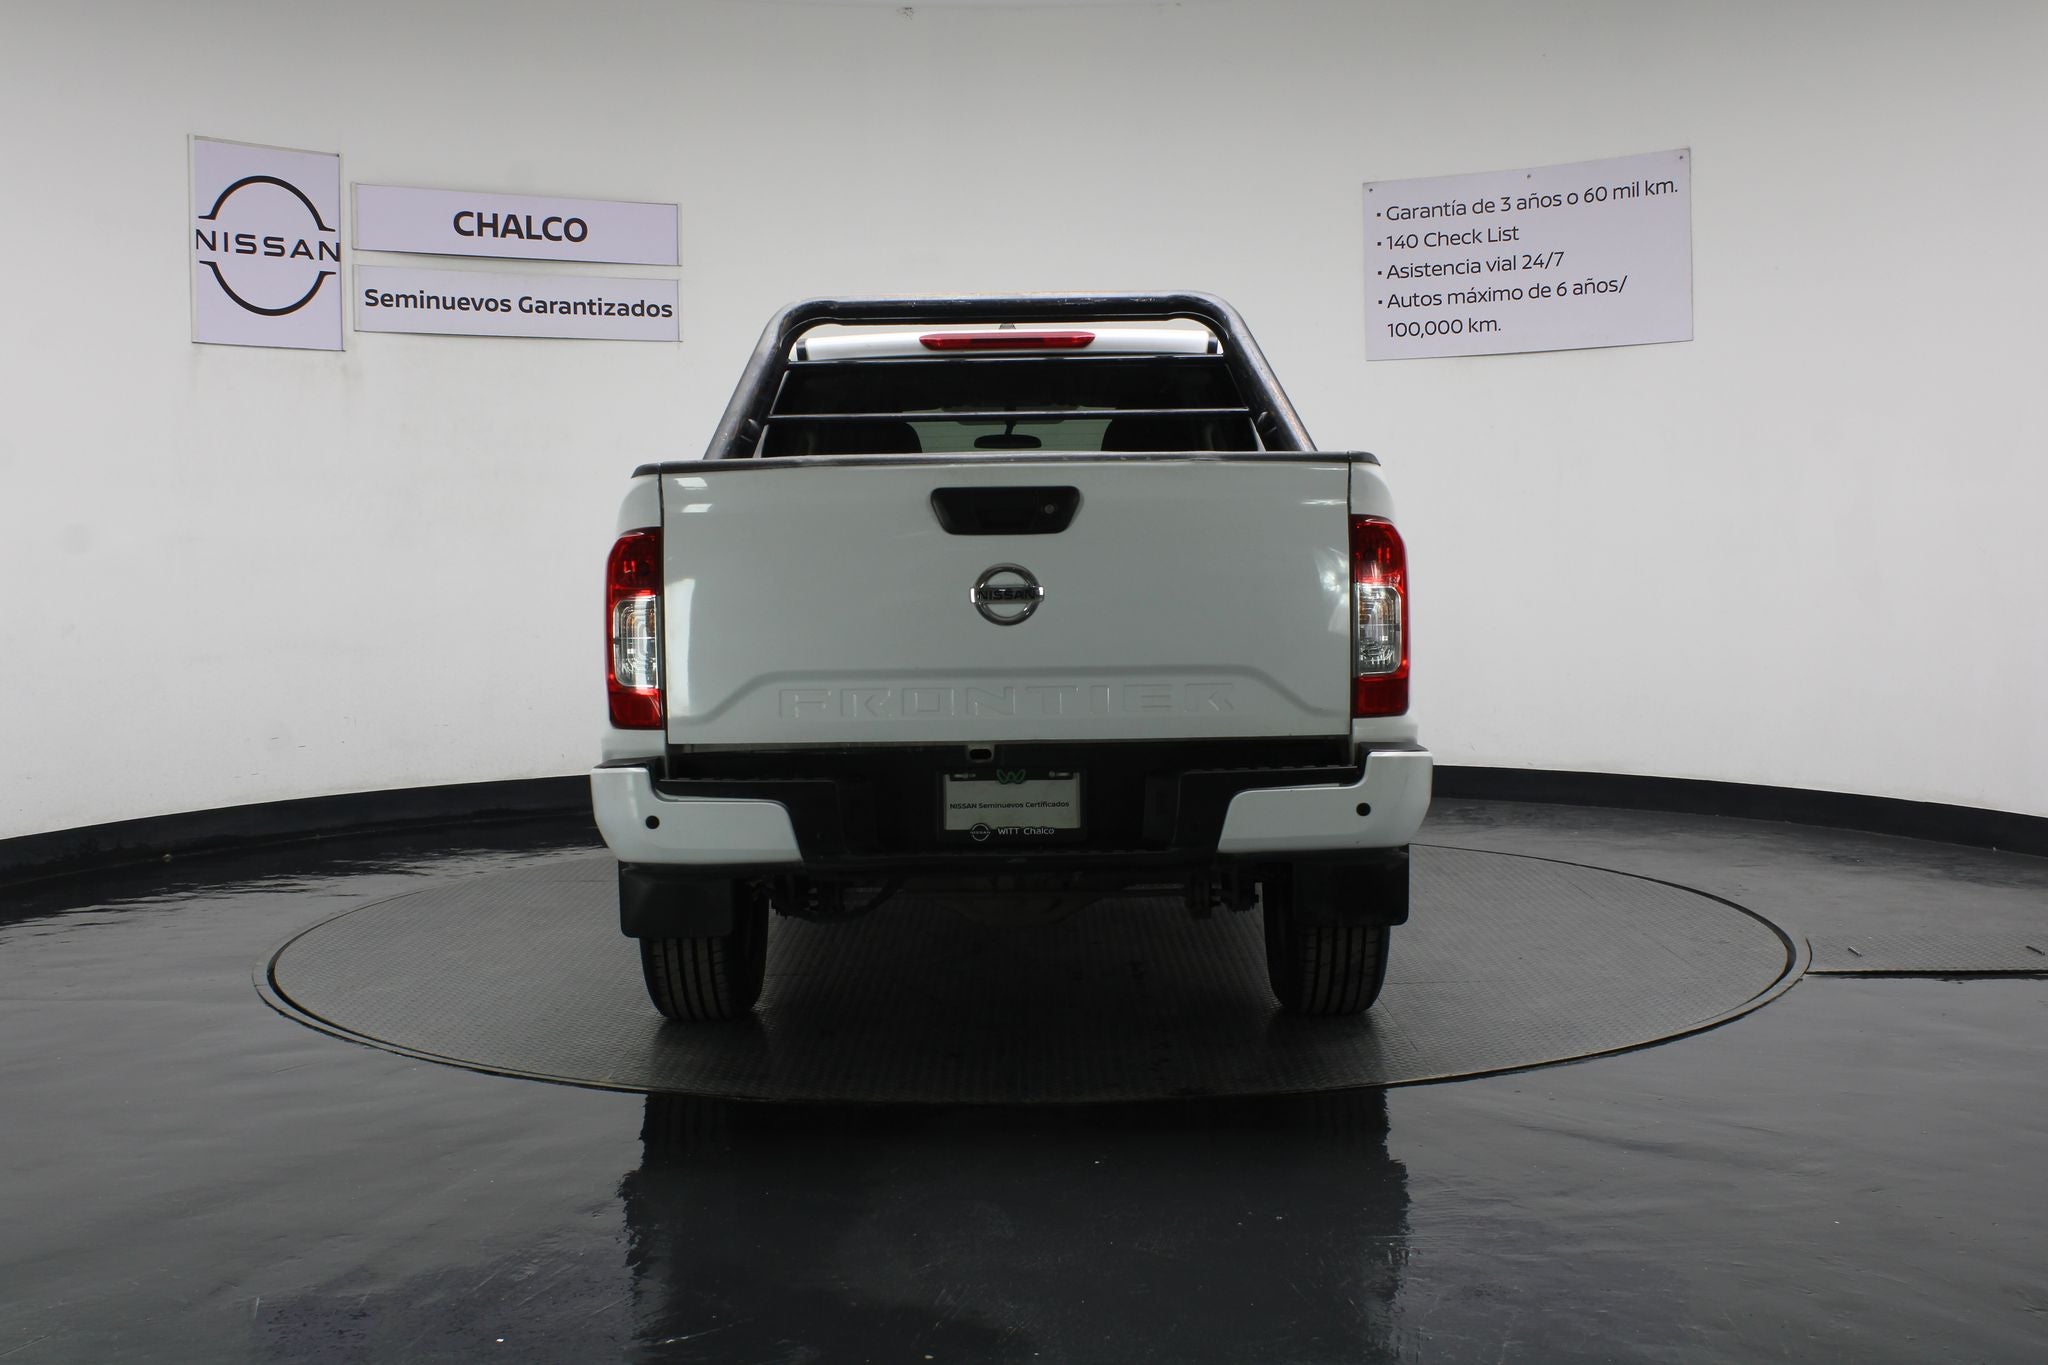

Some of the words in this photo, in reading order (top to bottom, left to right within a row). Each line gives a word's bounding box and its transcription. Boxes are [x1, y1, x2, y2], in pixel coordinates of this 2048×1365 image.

[1386, 199, 1467, 221] Garantía
[1472, 198, 1495, 215] de
[1500, 196, 1511, 213] 3
[1516, 192, 1562, 211] años
[1567, 192, 1579, 206] o
[1584, 185, 1608, 204] 60
[1612, 181, 1640, 200] mil
[1645, 177, 1679, 196] km.
[453, 211, 588, 242] CHALCO
[1386, 233, 1419, 250] 140
[1423, 228, 1482, 248] Check
[1487, 225, 1520, 243] List
[195, 229, 341, 262] NISSAN
[1386, 257, 1482, 280] Asistencia
[1486, 255, 1517, 272] vial
[1521, 251, 1565, 271] 24/7
[364, 288, 512, 313] Seminuevos
[518, 295, 673, 318] Garantizados
[1387, 290, 1443, 309] Autos
[1447, 287, 1523, 306] máximo
[1528, 283, 1552, 300] de
[1556, 281, 1568, 297] 6
[1572, 275, 1628, 296] años/
[1387, 319, 1463, 339] 100,000
[1468, 316, 1502, 333] km.
[978, 590, 1036, 600] NISSAN
[778, 682, 1236, 718] FRONTIER
[949, 802, 978, 810] NISSAN
[1023, 827, 1055, 835] Chalco
